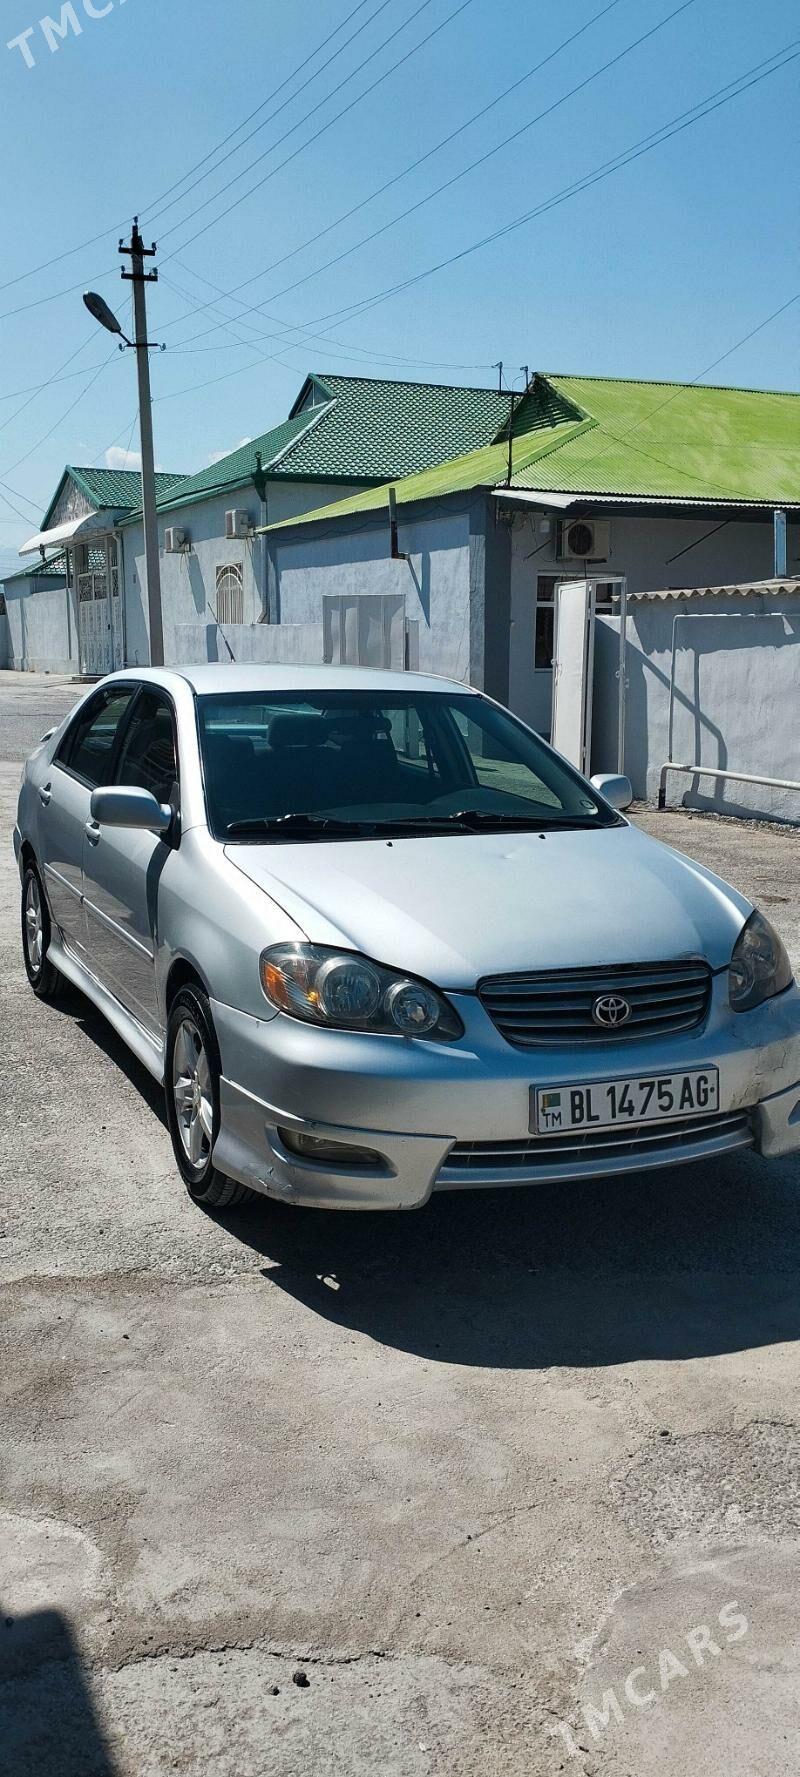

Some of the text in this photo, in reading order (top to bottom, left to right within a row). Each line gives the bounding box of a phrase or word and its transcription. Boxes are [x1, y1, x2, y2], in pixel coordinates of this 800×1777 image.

[570, 1075, 709, 1124] BL 1475 AG
[544, 1111, 562, 1128] TM
